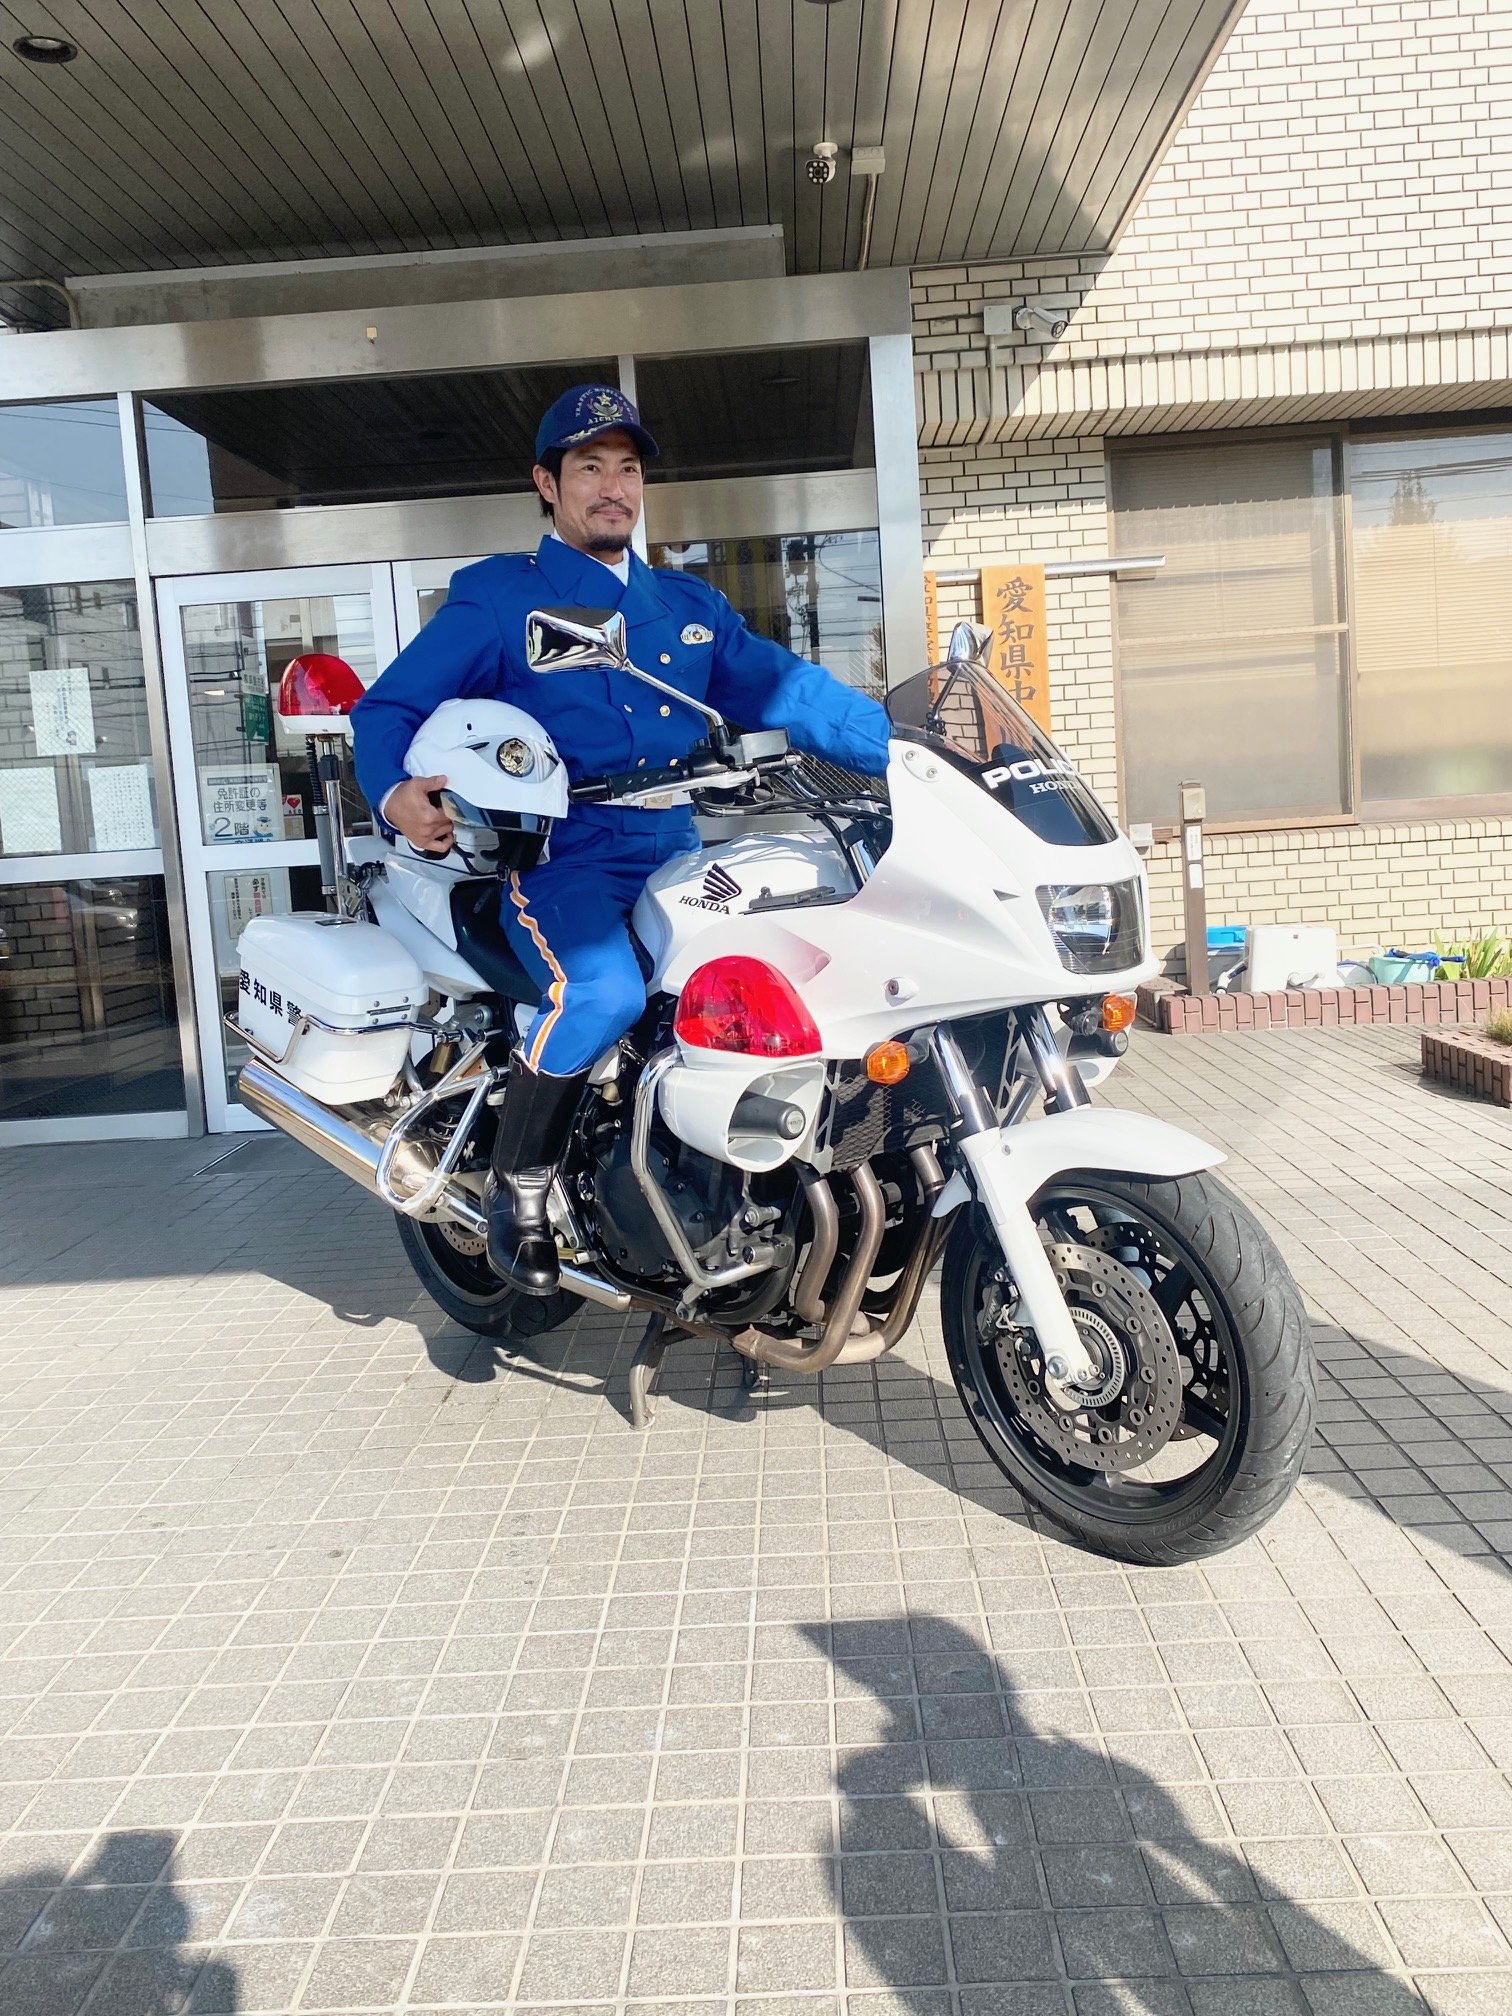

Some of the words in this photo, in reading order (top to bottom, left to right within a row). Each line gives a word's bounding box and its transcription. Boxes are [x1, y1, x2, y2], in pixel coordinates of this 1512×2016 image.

[981, 758, 1077, 790] POLIC
[217, 786, 261, 800] 免許証の
[1029, 780, 1078, 795] HOND
[214, 816, 250, 838] 2階
[678, 895, 730, 915] HONDA
